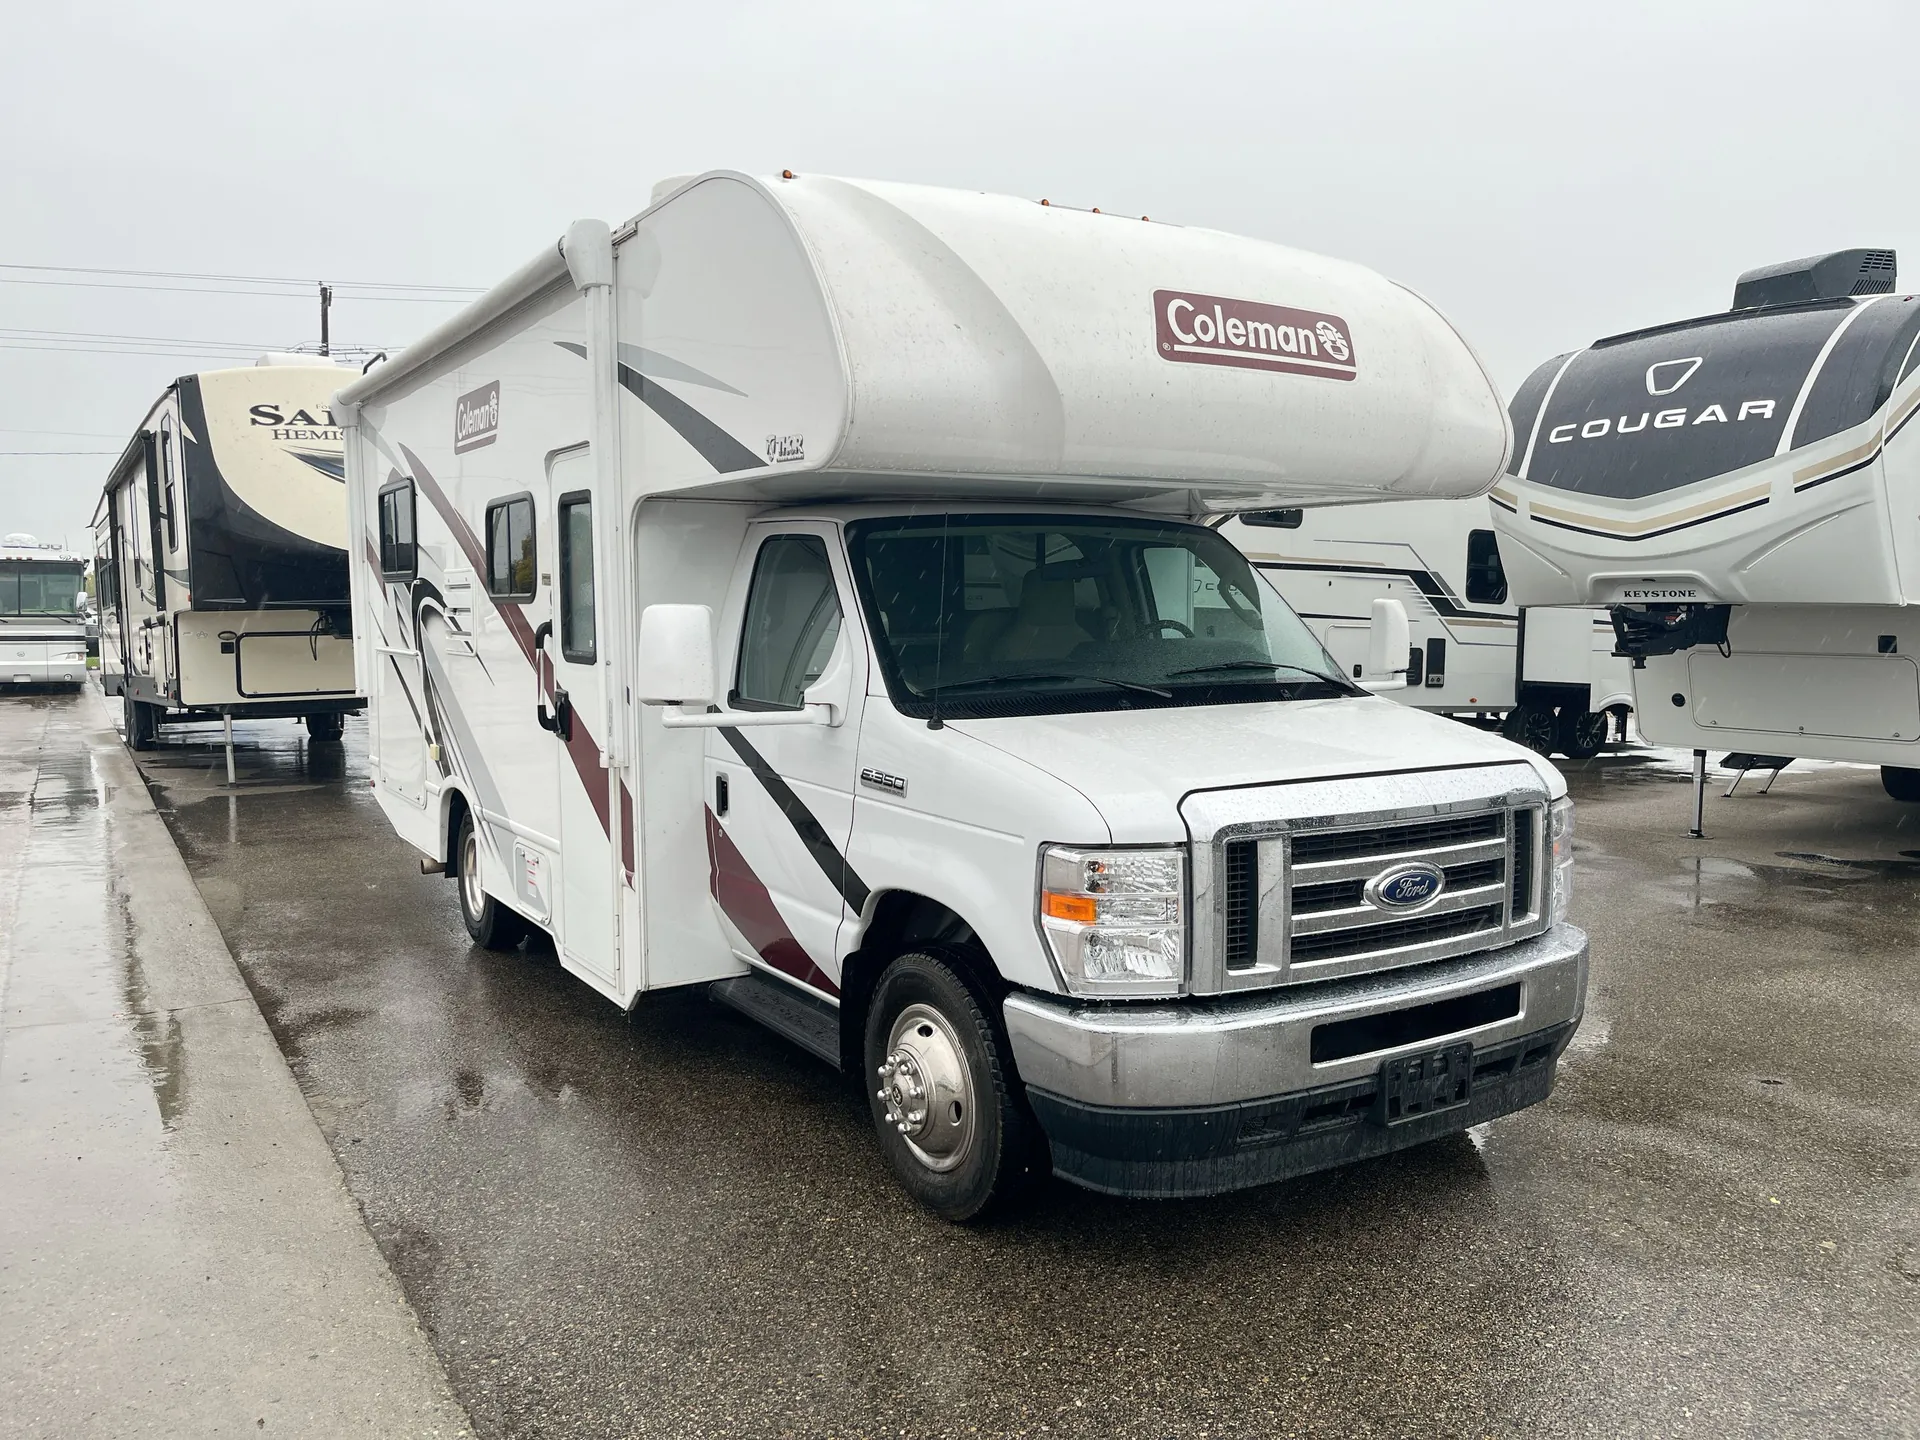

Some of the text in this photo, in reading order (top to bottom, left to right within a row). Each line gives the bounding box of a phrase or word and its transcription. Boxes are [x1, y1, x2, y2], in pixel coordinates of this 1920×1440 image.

[1167, 298, 1318, 356] Coleman
[457, 400, 490, 440] Coleman
[1549, 399, 1776, 444] COUGAR
[1624, 589, 1697, 598] KEYSTONE
[1395, 877, 1429, 899] Ford
